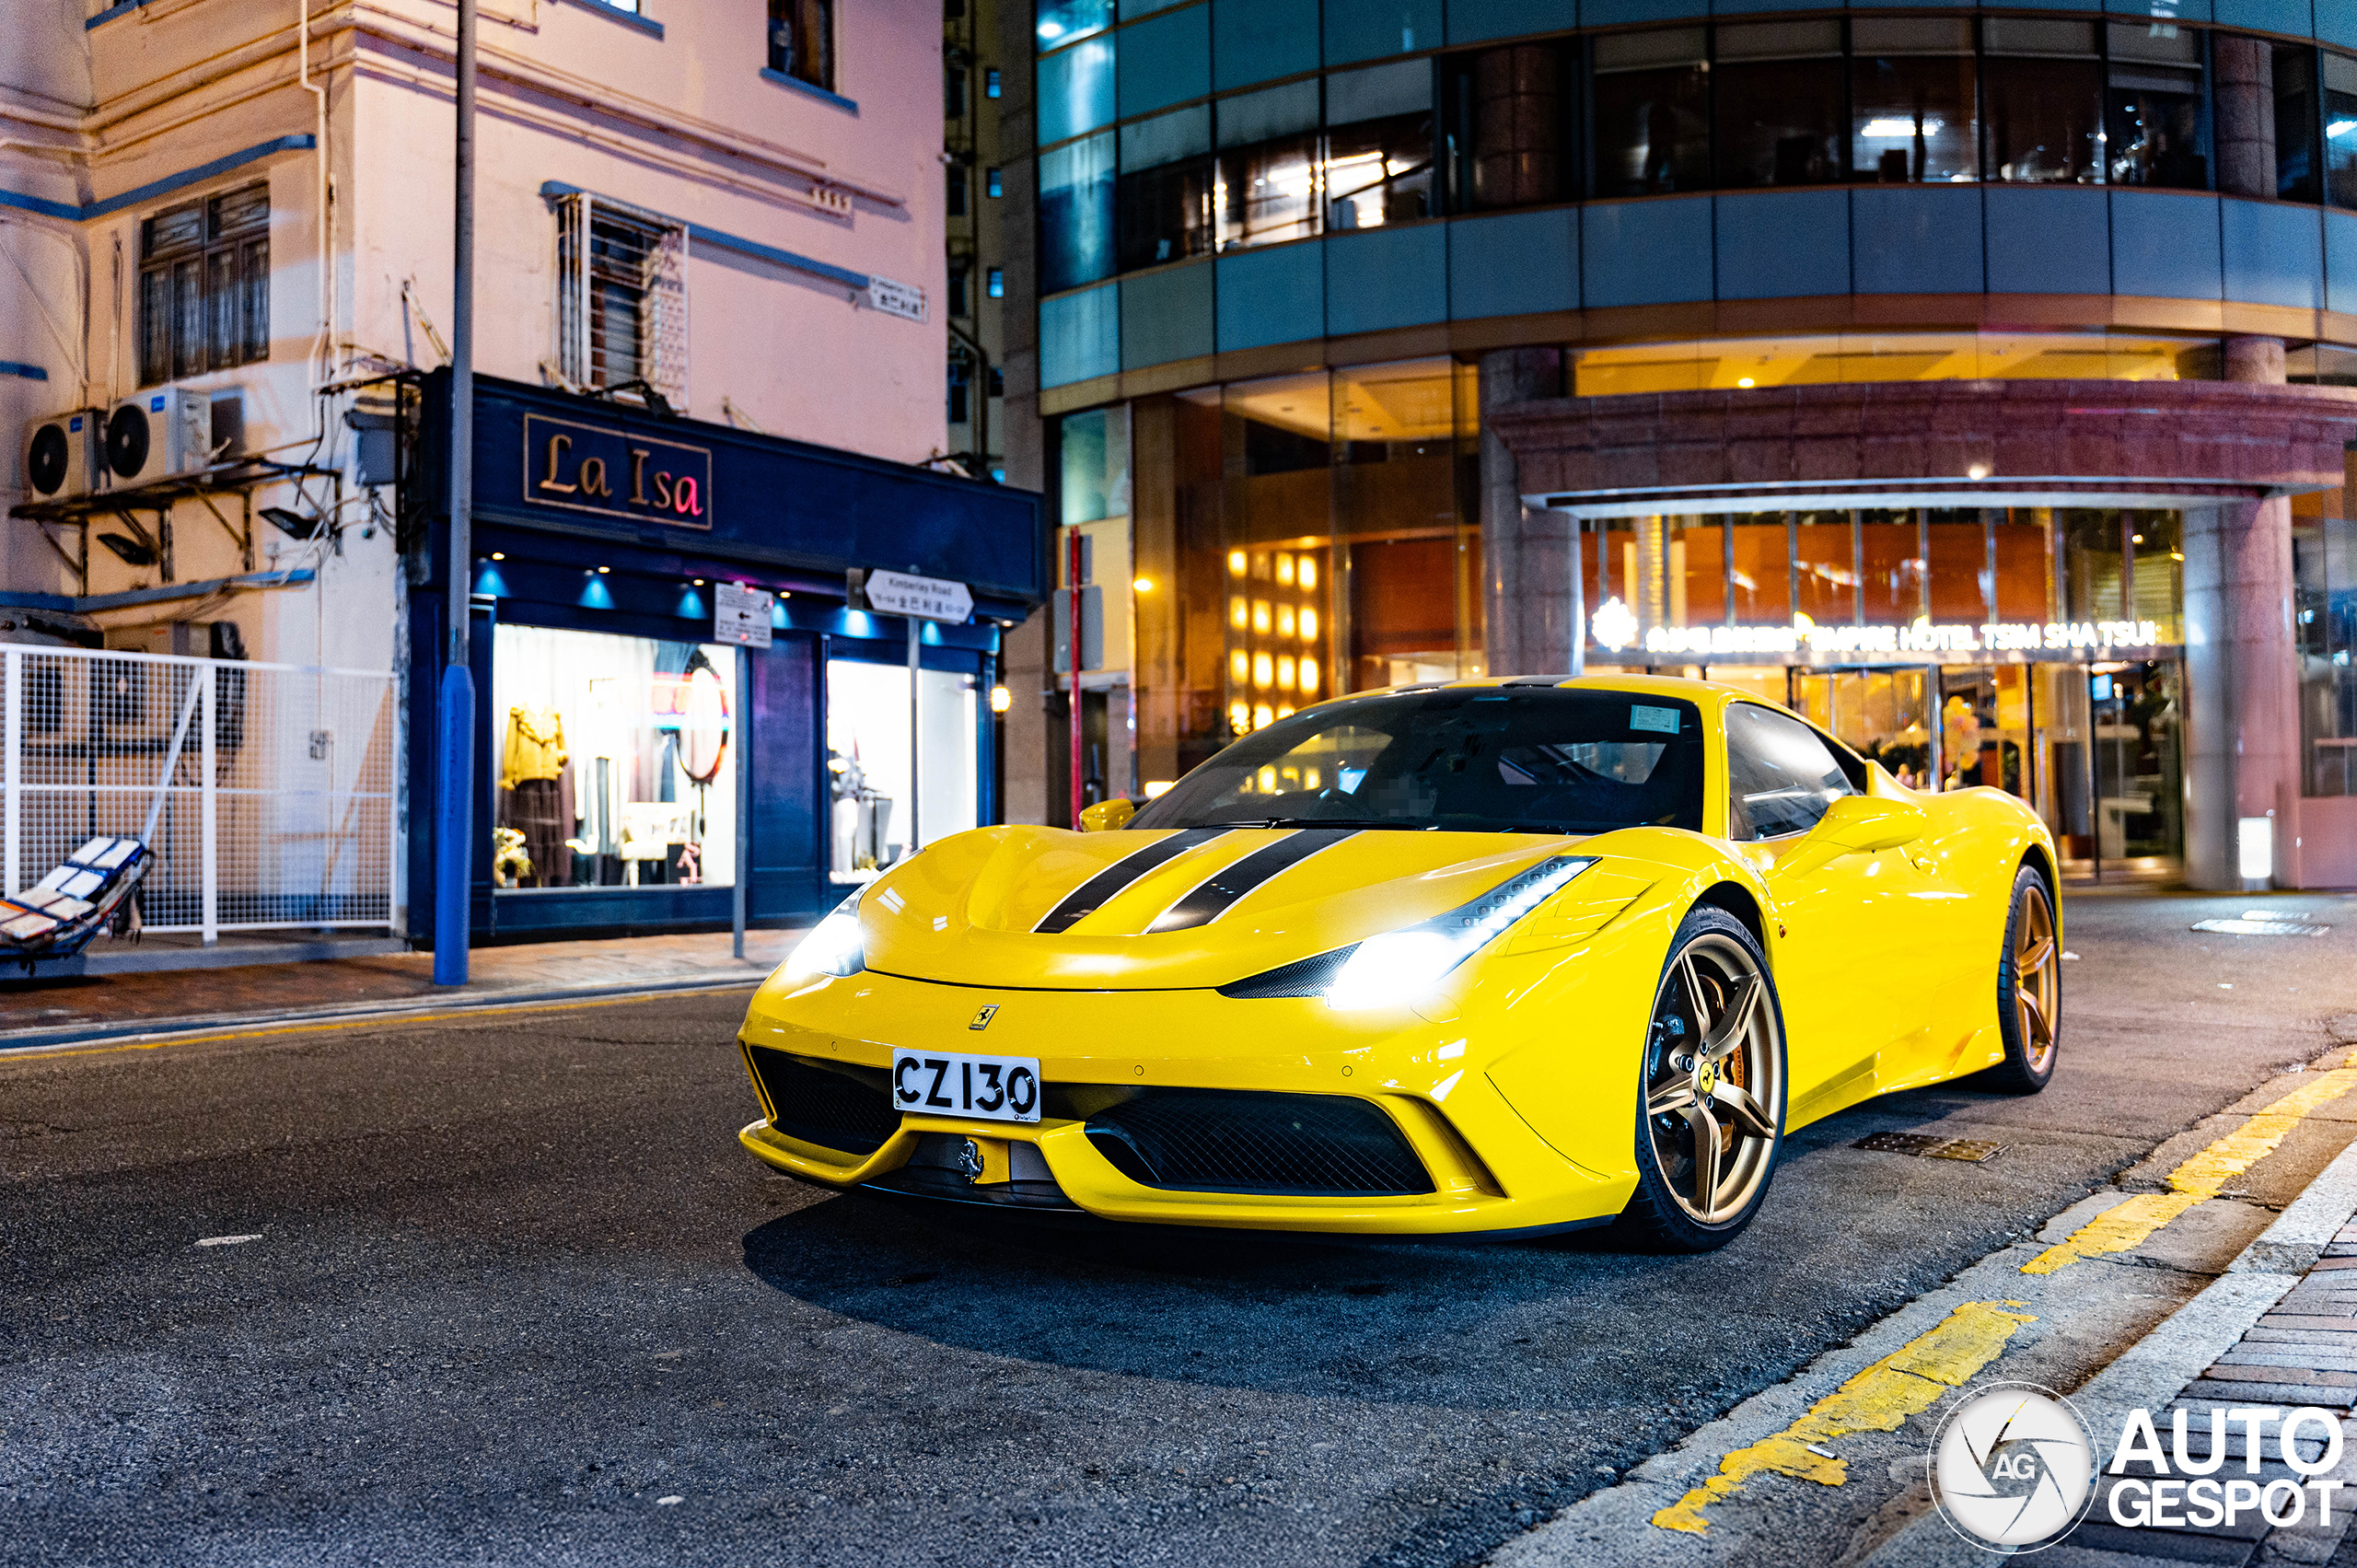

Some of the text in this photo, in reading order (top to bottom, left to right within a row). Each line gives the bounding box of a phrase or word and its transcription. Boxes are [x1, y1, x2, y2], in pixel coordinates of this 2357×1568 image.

[540, 435, 703, 517] La Isa
[888, 577, 952, 597] Kimberley Road
[899, 596, 943, 614] 金巴利道
[1810, 626, 1898, 651] EMPIRE
[1899, 624, 1980, 650] HOTEL
[1980, 623, 2042, 650] TSIM
[2043, 621, 2098, 648] SHA
[2097, 620, 2156, 647] TSUI
